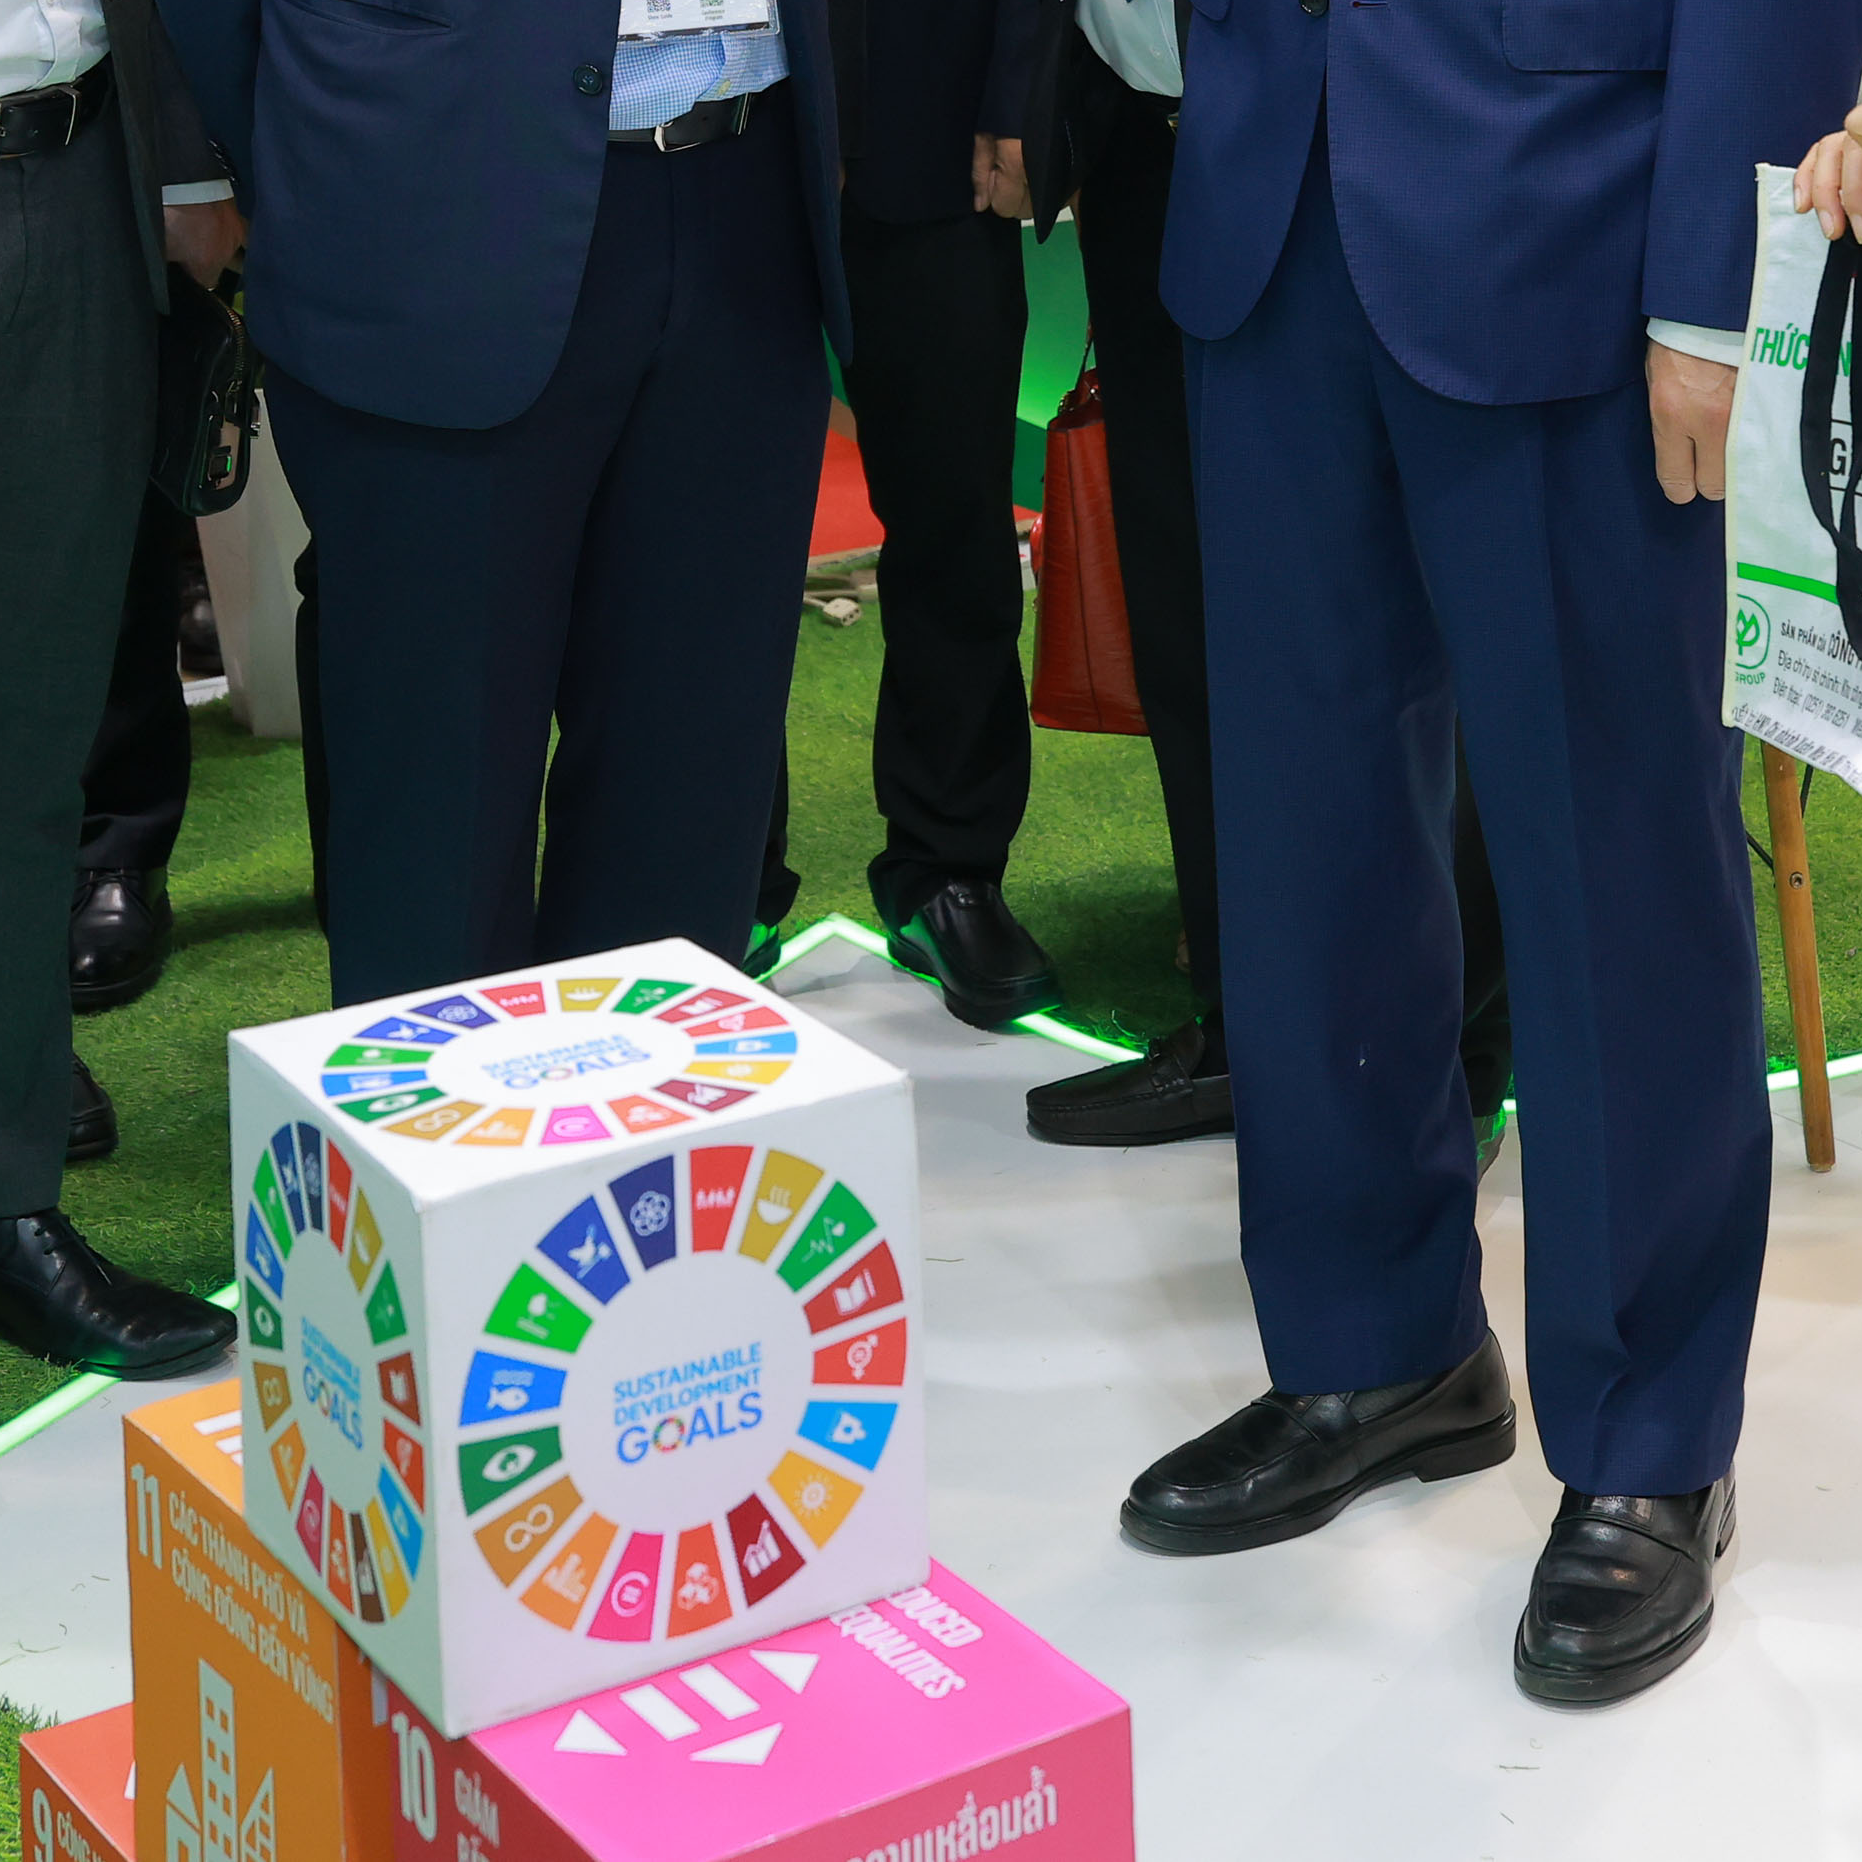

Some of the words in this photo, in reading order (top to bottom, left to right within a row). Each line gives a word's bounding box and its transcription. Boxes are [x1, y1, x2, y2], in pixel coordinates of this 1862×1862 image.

[1750, 323, 1809, 370] THỨC
[503, 1046, 652, 1089] GOALS
[613, 1343, 762, 1402] SUSTAINABLE
[614, 1368, 761, 1427] DEVELOPMENT
[617, 1391, 764, 1466] GOALS
[130, 1463, 162, 1569] 11
[169, 1490, 198, 1546] CÁC
[202, 1518, 250, 1597] THÀNH
[253, 1555, 285, 1623] PHỐ
[287, 1590, 309, 1644] VÀ
[171, 1548, 213, 1613] CỘNG
[214, 1581, 257, 1653] ĐỒNG
[292, 1647, 334, 1724] VỮNG
[391, 1711, 437, 1842] 10
[33, 1788, 54, 1862] 9
